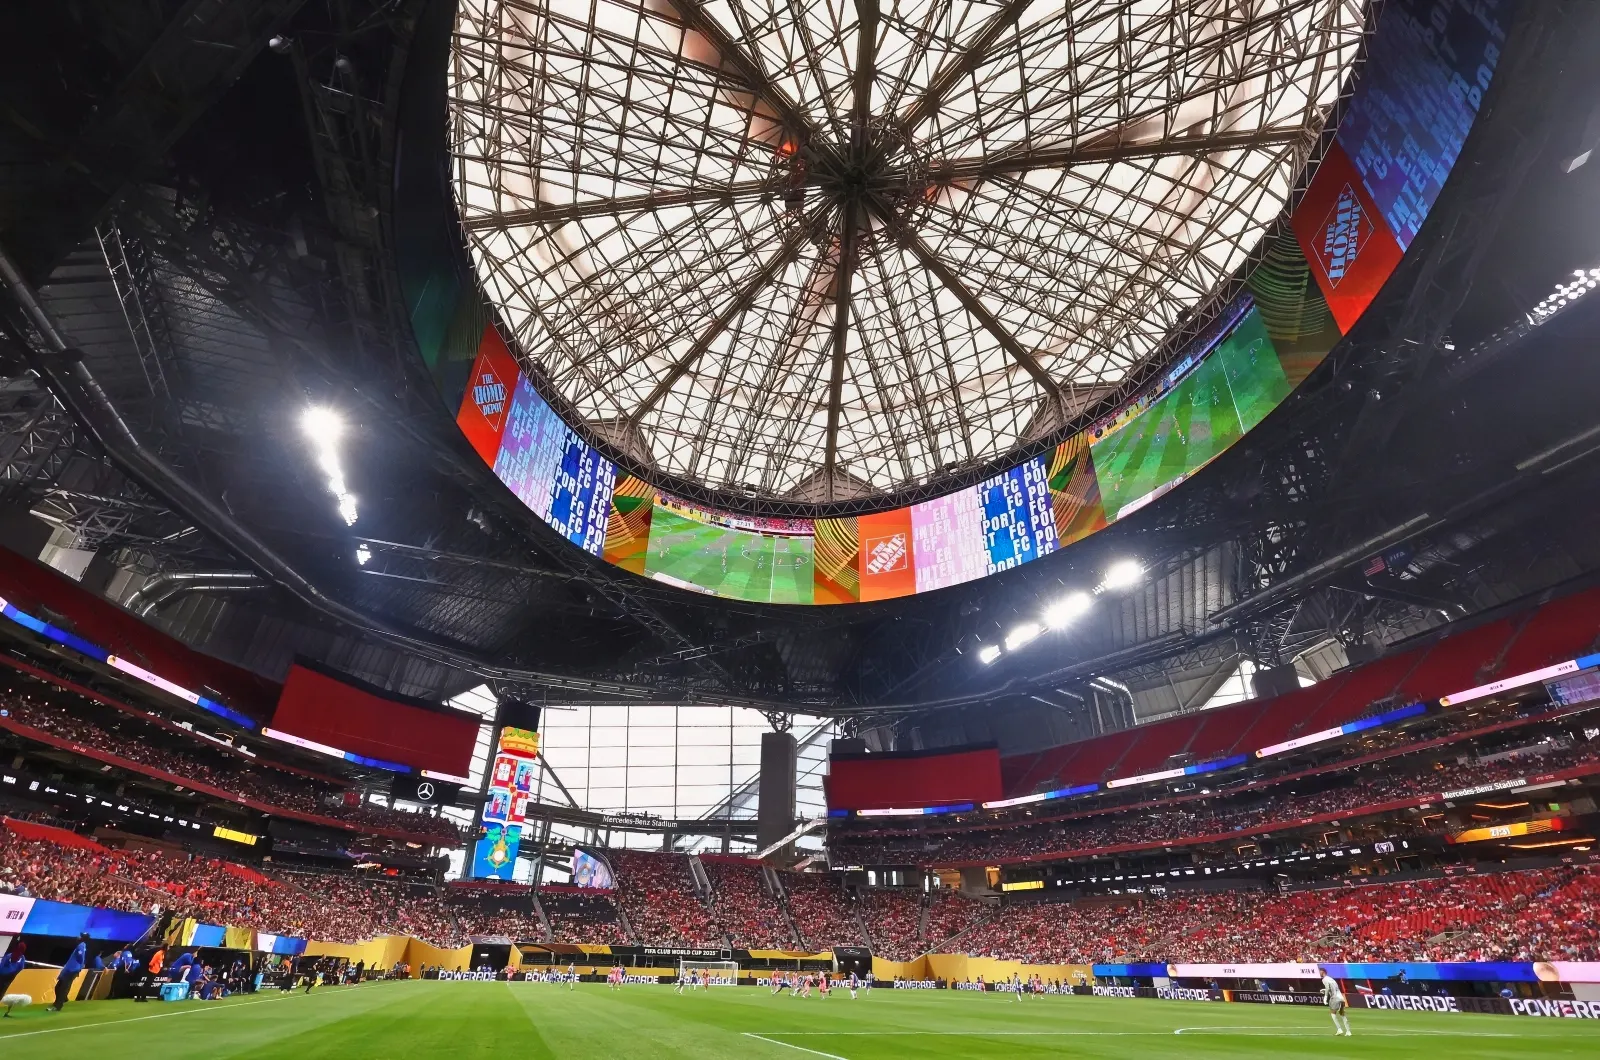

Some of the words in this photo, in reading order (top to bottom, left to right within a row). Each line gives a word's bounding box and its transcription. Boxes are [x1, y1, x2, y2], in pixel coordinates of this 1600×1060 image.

[1323, 222, 1336, 255] THE
[1328, 192, 1354, 279] HOME
[481, 373, 494, 384] THE
[473, 383, 505, 405] HOME
[482, 402, 503, 416] DEPOT
[579, 453, 592, 473] FC
[577, 468, 592, 489] FC
[1002, 478, 1019, 497] FC
[554, 467, 582, 499] PORT
[591, 494, 606, 515] FC
[569, 495, 585, 517] FC
[1006, 492, 1024, 511] FC
[567, 512, 583, 534] FC
[982, 509, 1016, 533] PORT
[1029, 496, 1047, 516] FC
[1008, 521, 1026, 540] FC
[867, 533, 906, 574] HOME
[870, 541, 887, 556] THE
[1012, 535, 1031, 555] FC
[883, 546, 907, 572] DEPOT
[1442, 784, 1494, 800] Mercedes-Benz
[1494, 777, 1527, 790] Stadium
[602, 815, 651, 826] Mercedes-Benz
[651, 819, 678, 828] Stadium
[438, 971, 497, 981] POWERADE
[893, 981, 937, 989] POWERADE
[1092, 985, 1135, 998] POWERADE
[1156, 987, 1211, 1001] POWERADE
[1294, 995, 1308, 1003] CUP
[1364, 993, 1457, 1012] POWERADE
